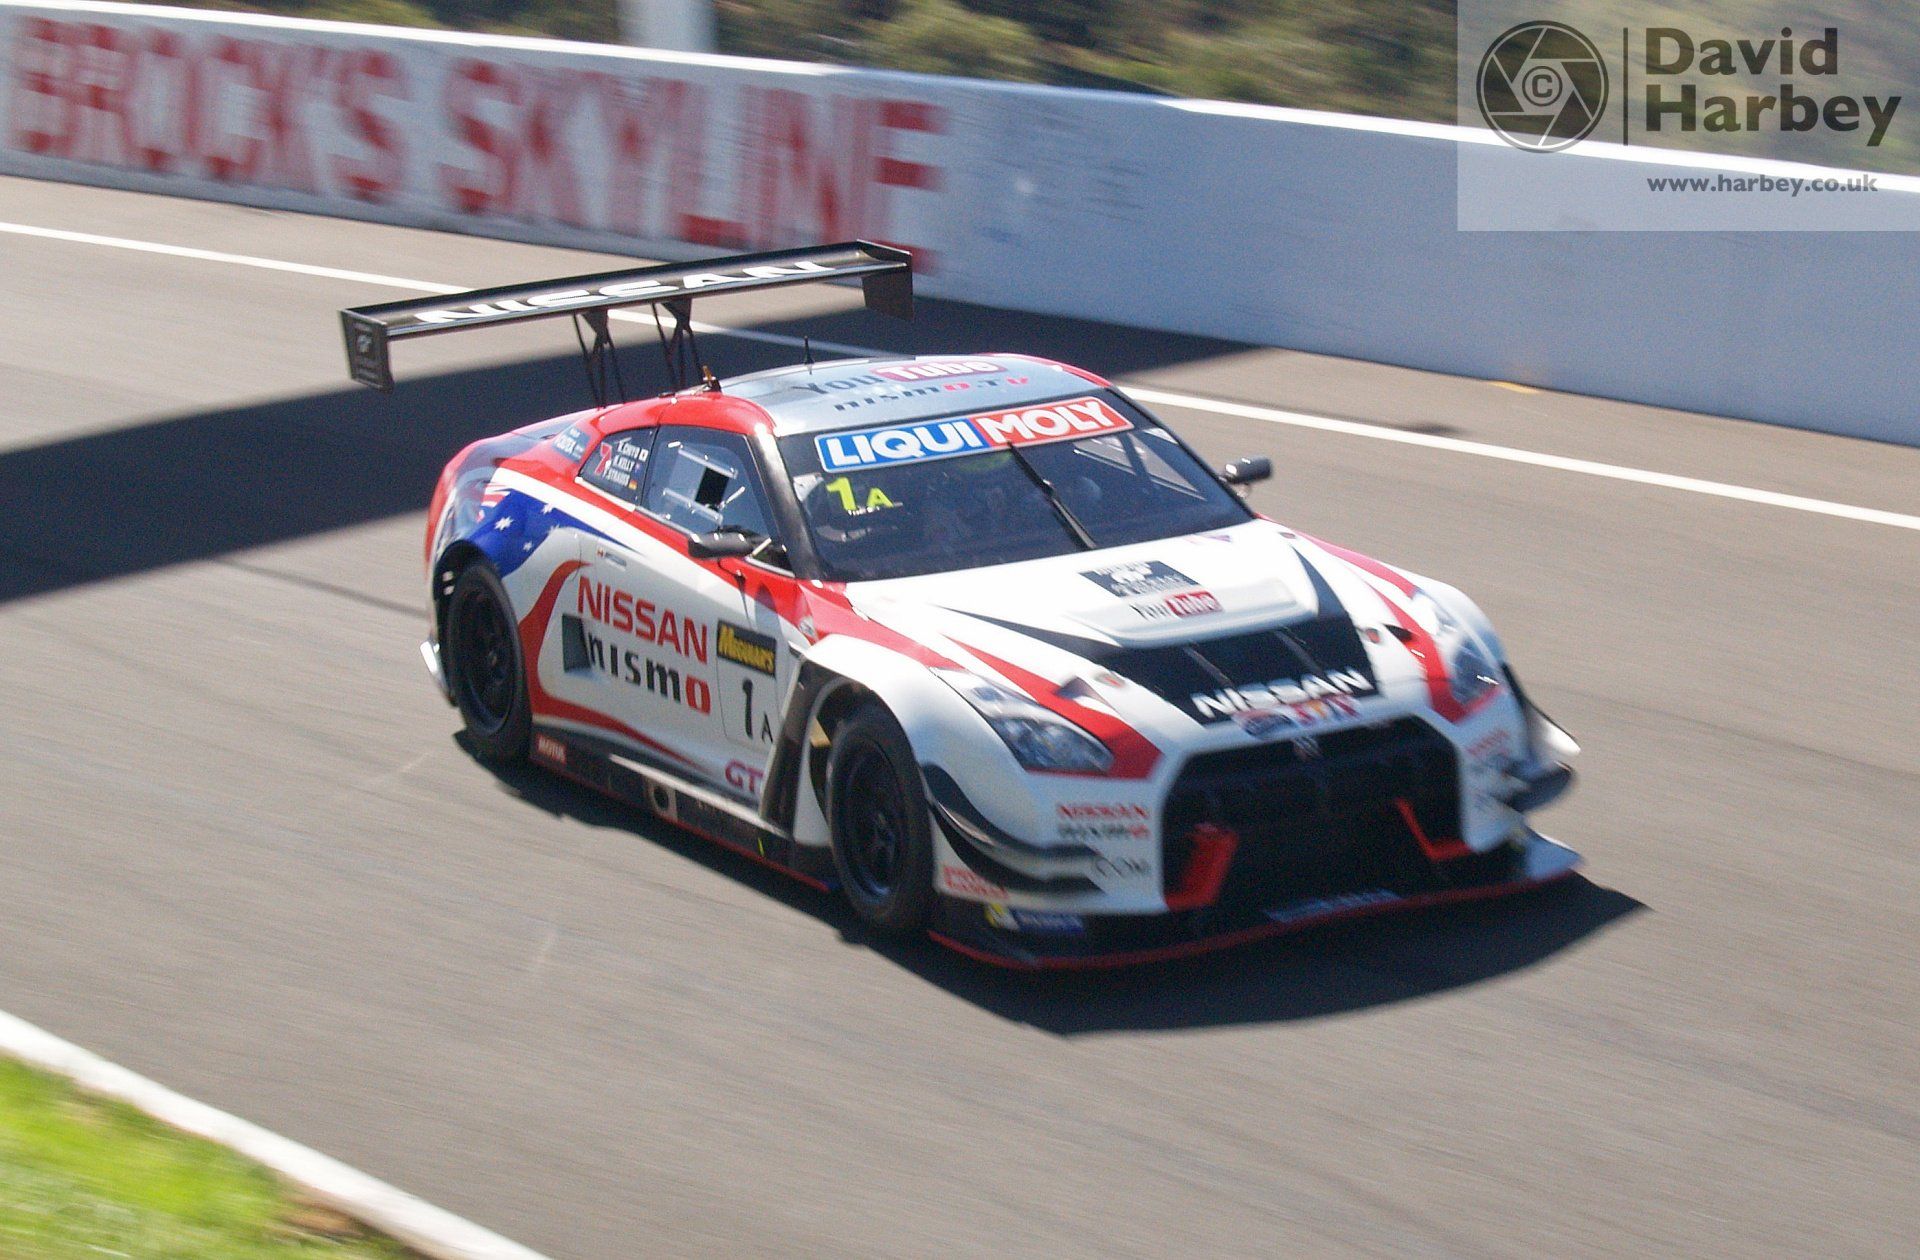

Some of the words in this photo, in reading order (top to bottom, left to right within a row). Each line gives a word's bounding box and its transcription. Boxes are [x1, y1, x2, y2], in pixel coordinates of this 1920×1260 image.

[437, 57, 948, 276] SKYLINE
[414, 260, 836, 325] NISSAN
[826, 418, 983, 467] LIQUI
[976, 400, 1114, 443] MOLY
[577, 575, 708, 666] NISSAN
